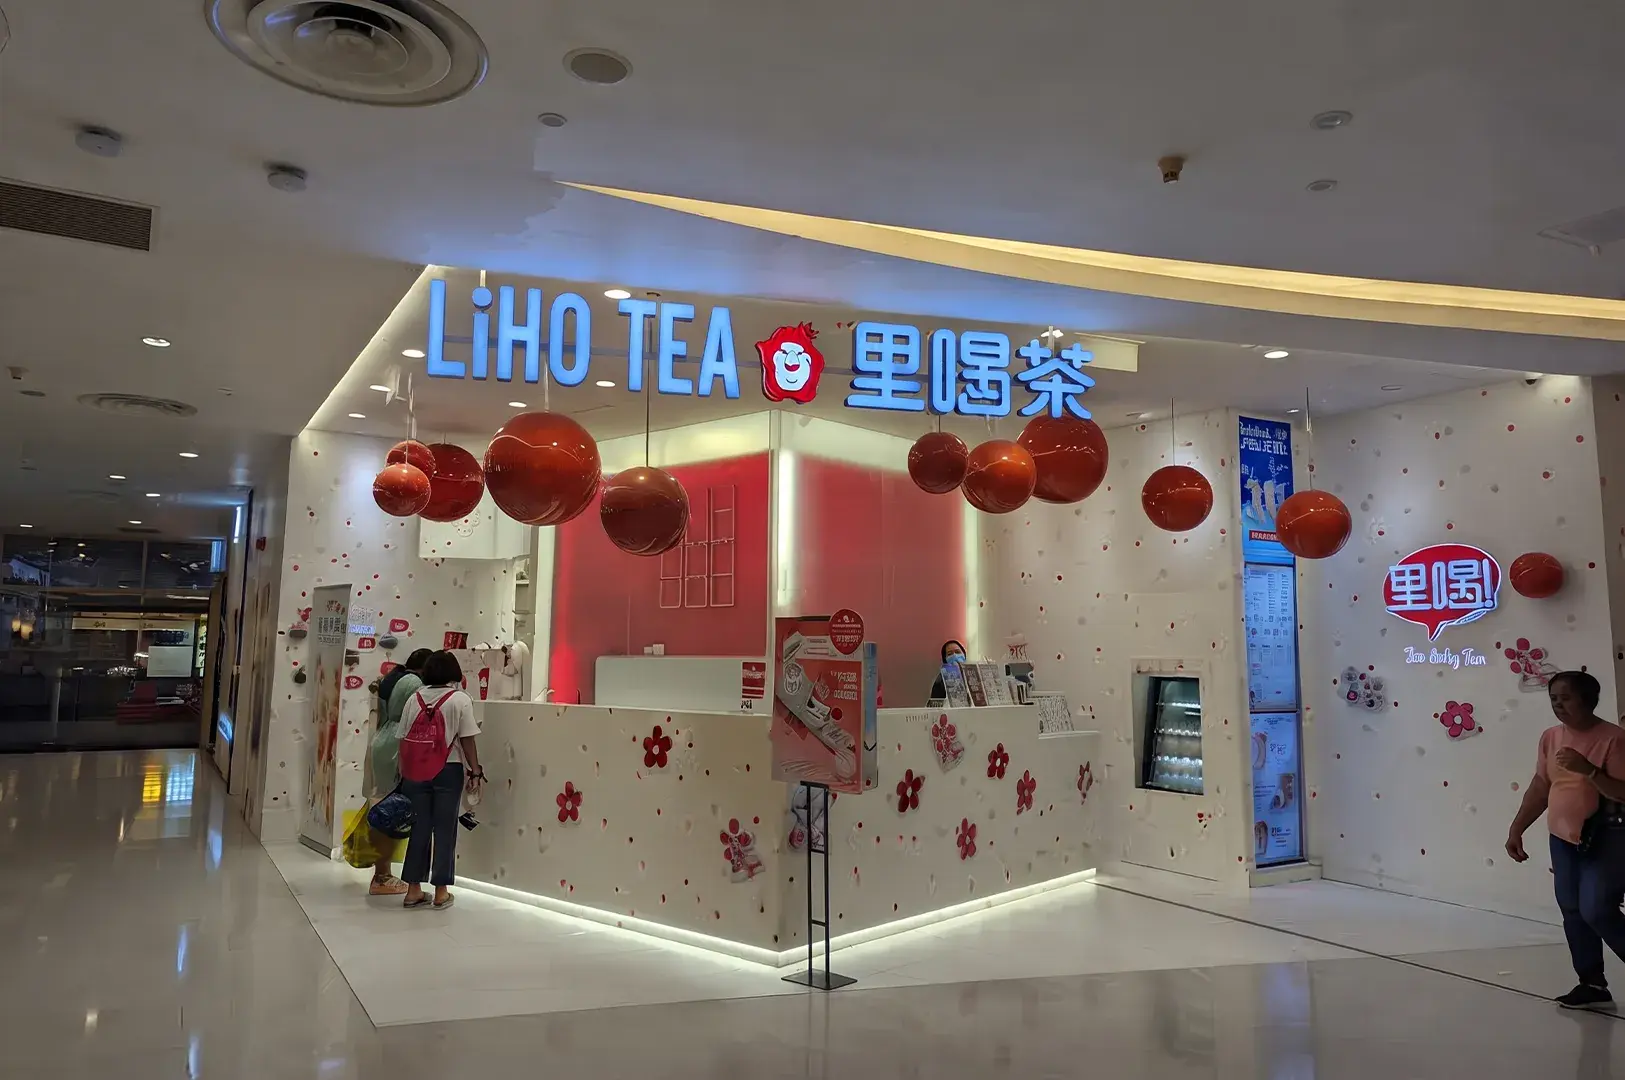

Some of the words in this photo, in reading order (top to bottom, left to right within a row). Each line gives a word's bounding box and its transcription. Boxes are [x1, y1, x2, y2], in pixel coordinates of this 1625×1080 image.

[427, 279, 592, 388] LiHO
[617, 299, 741, 399] TEA
[844, 321, 1097, 420] 里喝茶
